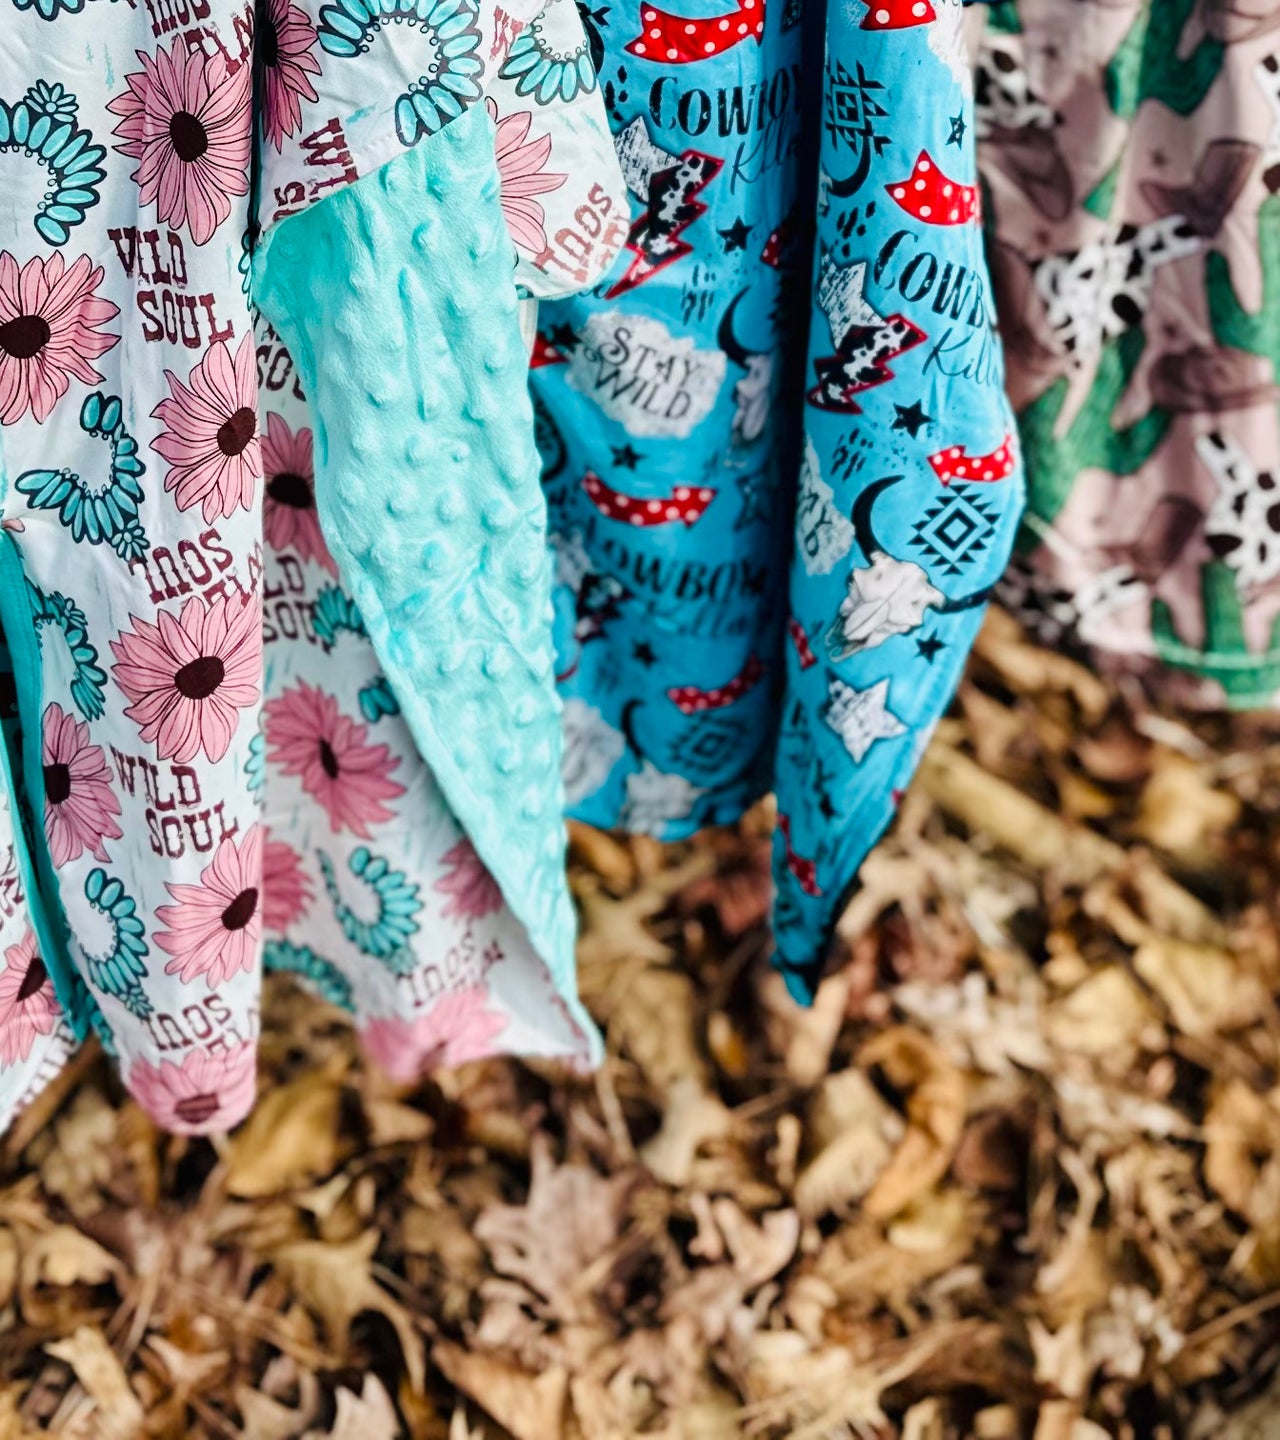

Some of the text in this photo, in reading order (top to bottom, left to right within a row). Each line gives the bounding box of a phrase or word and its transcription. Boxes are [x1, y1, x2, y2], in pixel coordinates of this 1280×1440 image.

[136, 291, 234, 348] SOUL
[111, 744, 203, 807] WILD
[147, 800, 238, 859] SOUL
